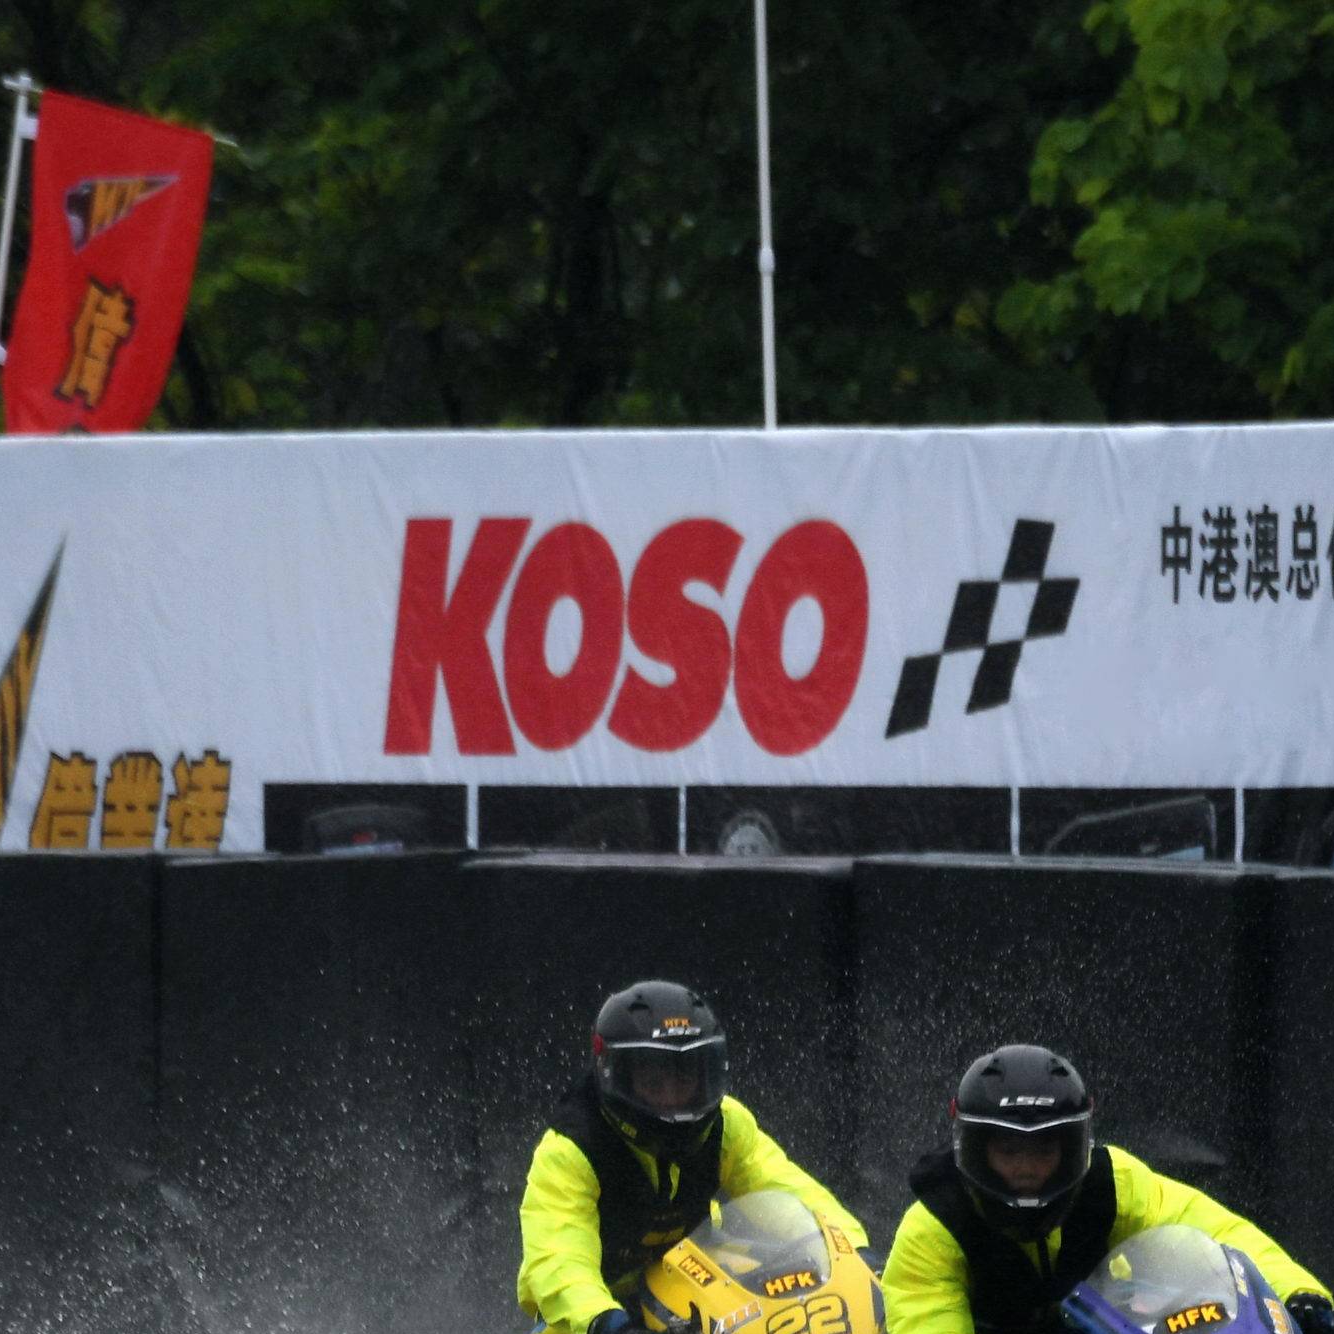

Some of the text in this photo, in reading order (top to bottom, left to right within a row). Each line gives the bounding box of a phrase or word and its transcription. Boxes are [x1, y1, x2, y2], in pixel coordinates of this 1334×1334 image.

[383, 517, 869, 756] KOSO
[765, 1271, 816, 1297] HFK
[1166, 1303, 1223, 1334] HFK
